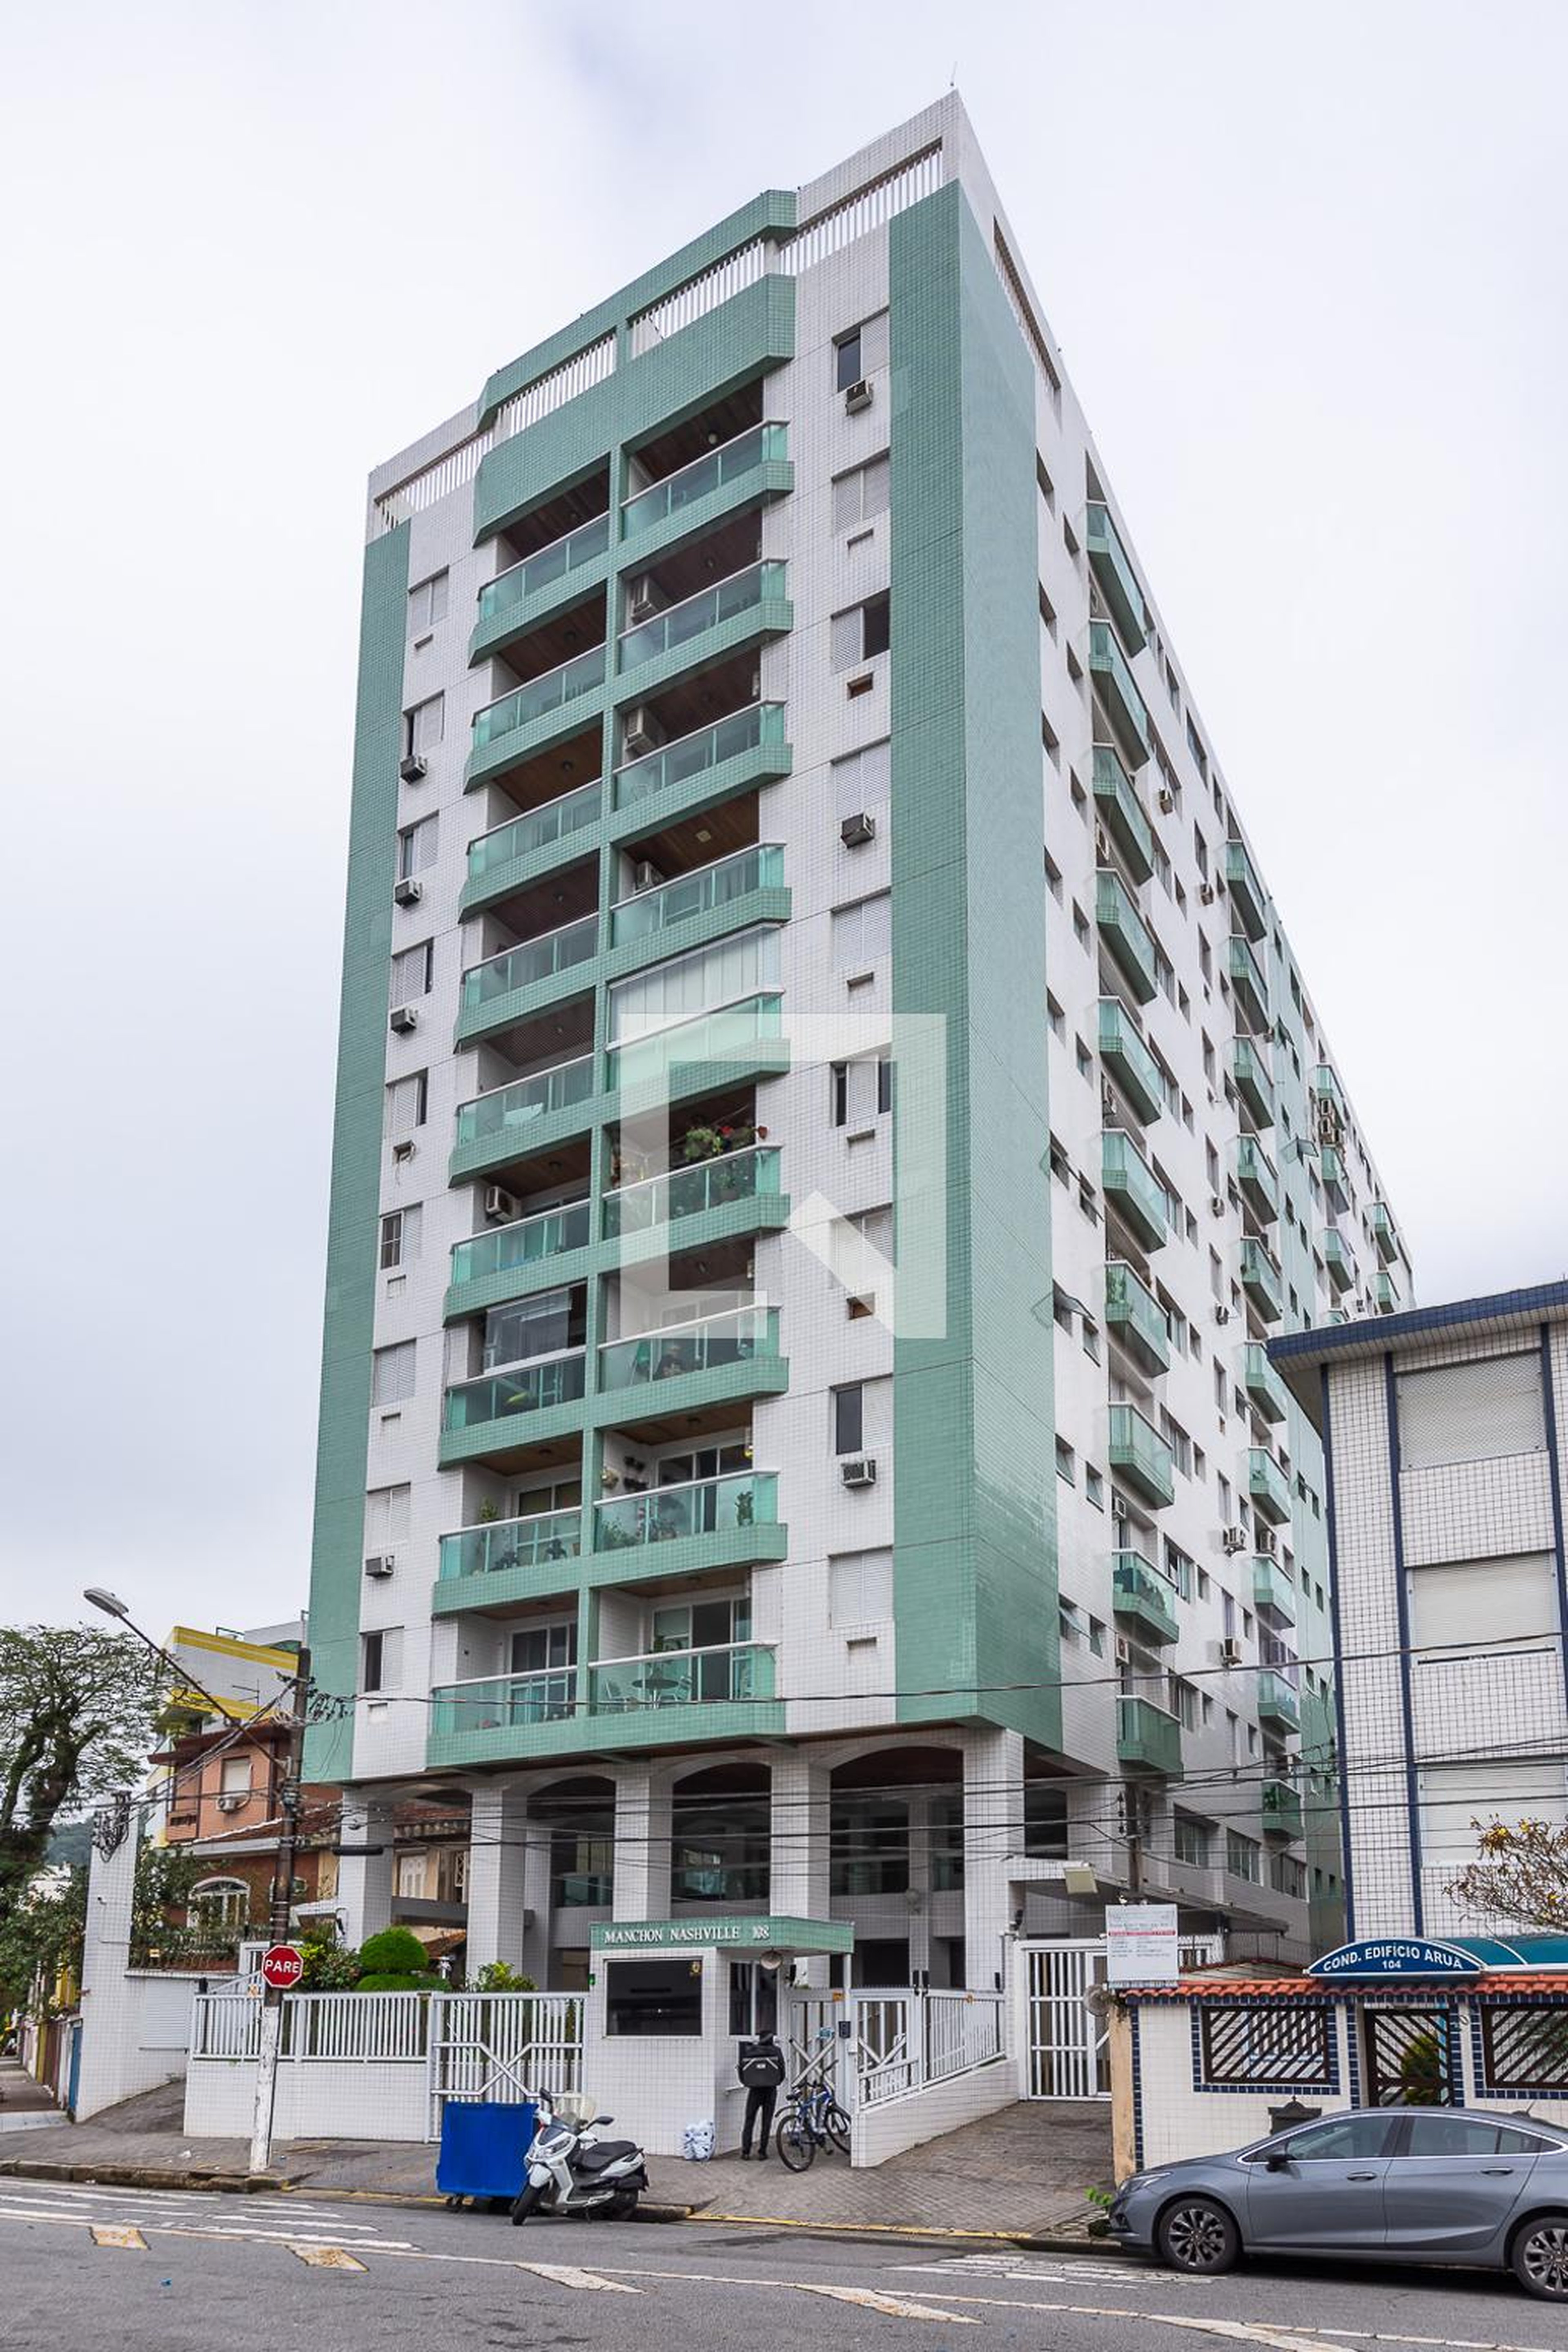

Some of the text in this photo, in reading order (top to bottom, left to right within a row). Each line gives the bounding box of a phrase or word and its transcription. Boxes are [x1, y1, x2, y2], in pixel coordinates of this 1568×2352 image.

[604, 1929, 662, 1943] MANCHON
[670, 1925, 740, 1941] NASHVILLE
[1323, 1952, 1361, 1971] COND.
[1365, 1942, 1420, 1960] EDIFÍCIO
[265, 1960, 300, 1973] PARE
[1382, 1960, 1401, 1969] 104
